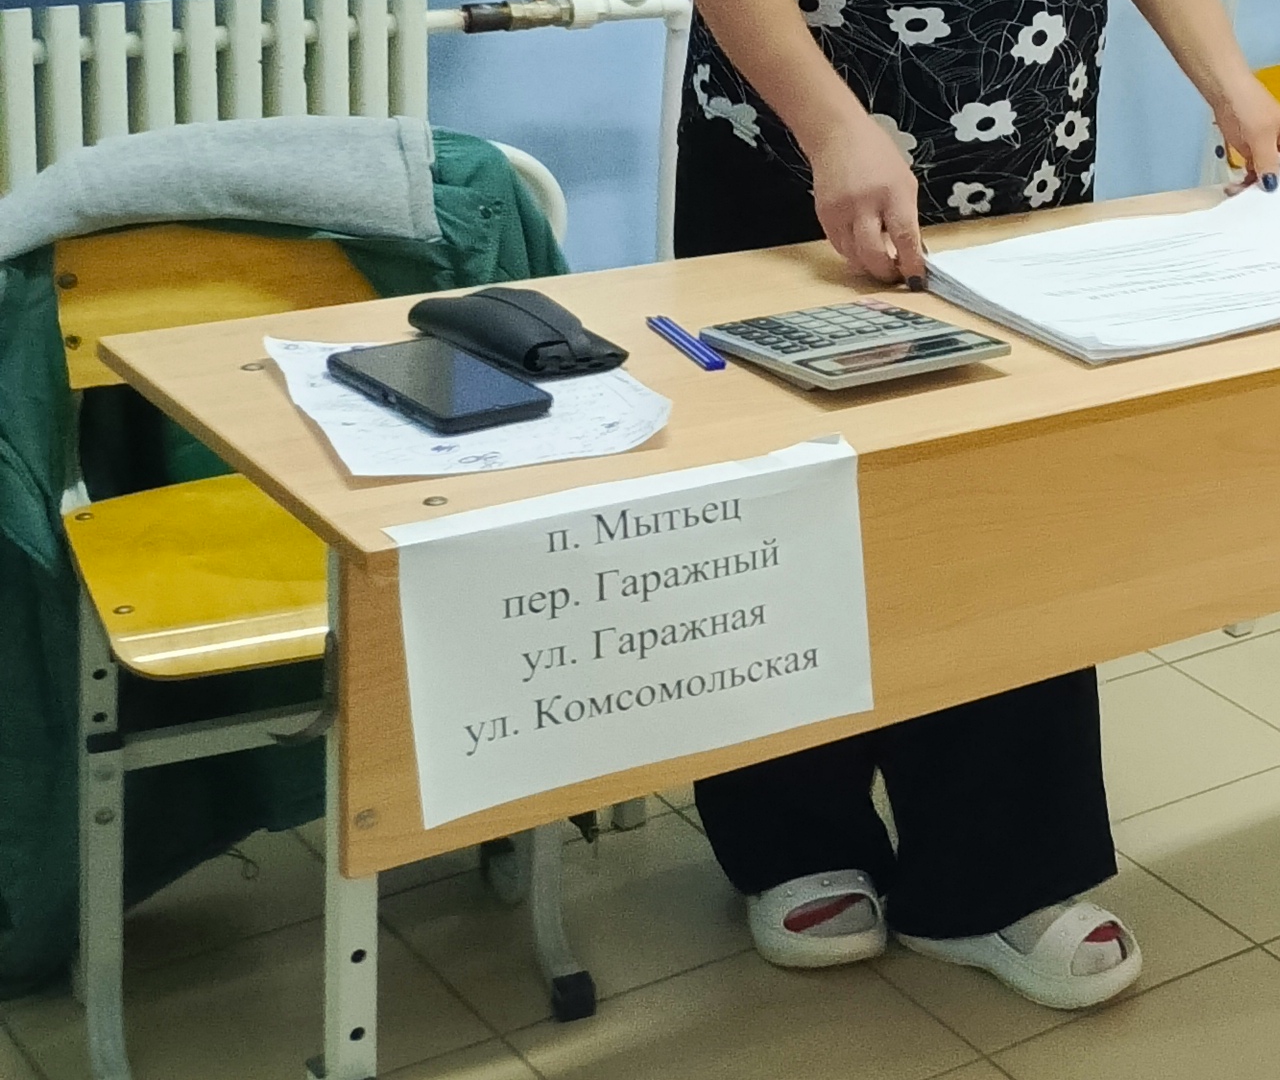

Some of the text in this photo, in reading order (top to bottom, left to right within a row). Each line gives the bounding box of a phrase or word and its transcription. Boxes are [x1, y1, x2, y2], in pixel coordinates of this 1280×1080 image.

[546, 497, 742, 554] п. Мытьец
[502, 538, 780, 621] пер. Гаражный
[522, 603, 767, 682] ул. Гаражная
[464, 647, 820, 756] ул. Комсомольская
